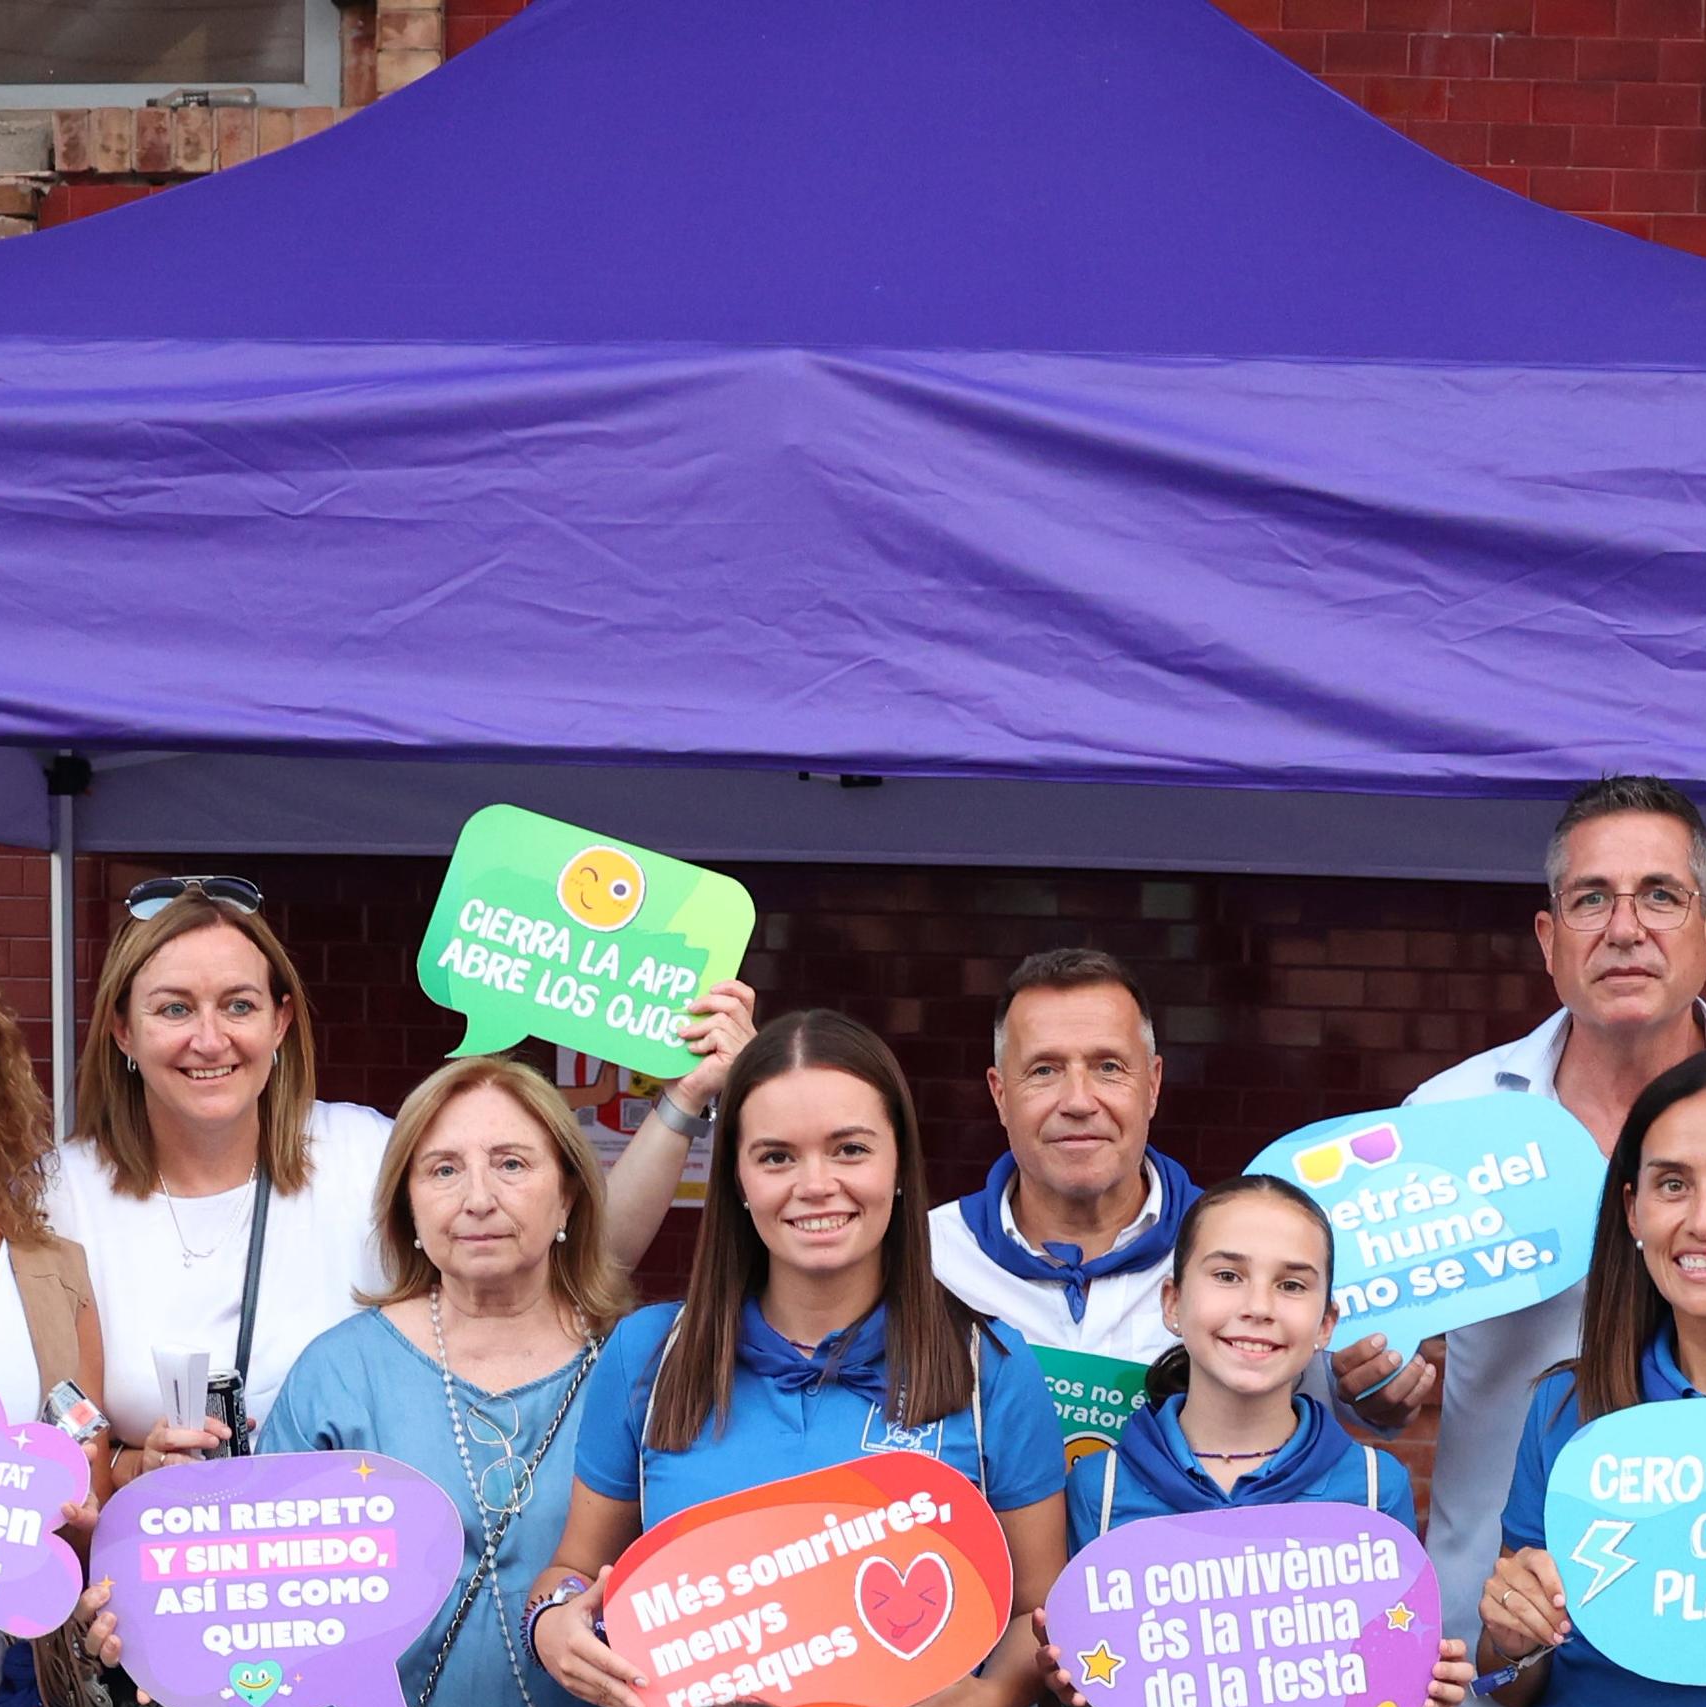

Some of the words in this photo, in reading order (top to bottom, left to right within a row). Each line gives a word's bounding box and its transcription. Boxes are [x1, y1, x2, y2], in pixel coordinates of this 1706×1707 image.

[458, 898, 571, 965] CIERRA
[578, 940, 620, 981] LA
[437, 938, 532, 994] ABRE
[534, 968, 601, 1019] LOS
[605, 996, 692, 1049] OJOS
[1321, 1172, 1459, 1232] etrás
[1466, 1141, 1549, 1196] del
[1355, 1204, 1504, 1268] humo
[1332, 1277, 1399, 1319] no
[1409, 1258, 1466, 1297] se
[1472, 1238, 1555, 1278] ve.
[1091, 1385, 1124, 1405] no
[1591, 1453, 1704, 1504] CERO
[139, 1505, 220, 1536] CON
[230, 1495, 395, 1531] RESPETO
[150, 1548, 177, 1575] Y
[186, 1544, 248, 1573] SIN
[258, 1536, 389, 1568] MIEDO,
[630, 1570, 727, 1633] Més
[726, 1491, 953, 1595] somriures,
[1084, 1565, 1134, 1613] La
[1144, 1532, 1401, 1606] convivència
[154, 1579, 218, 1616] ASÍ
[226, 1584, 268, 1610] ES
[277, 1576, 390, 1607] COMO
[1138, 1609, 1190, 1663] és
[1199, 1608, 1241, 1656] la
[1251, 1595, 1360, 1650] reina
[202, 1617, 346, 1656] QUIERO
[648, 1600, 789, 1678] menys
[1258, 1649, 1368, 1704] festa
